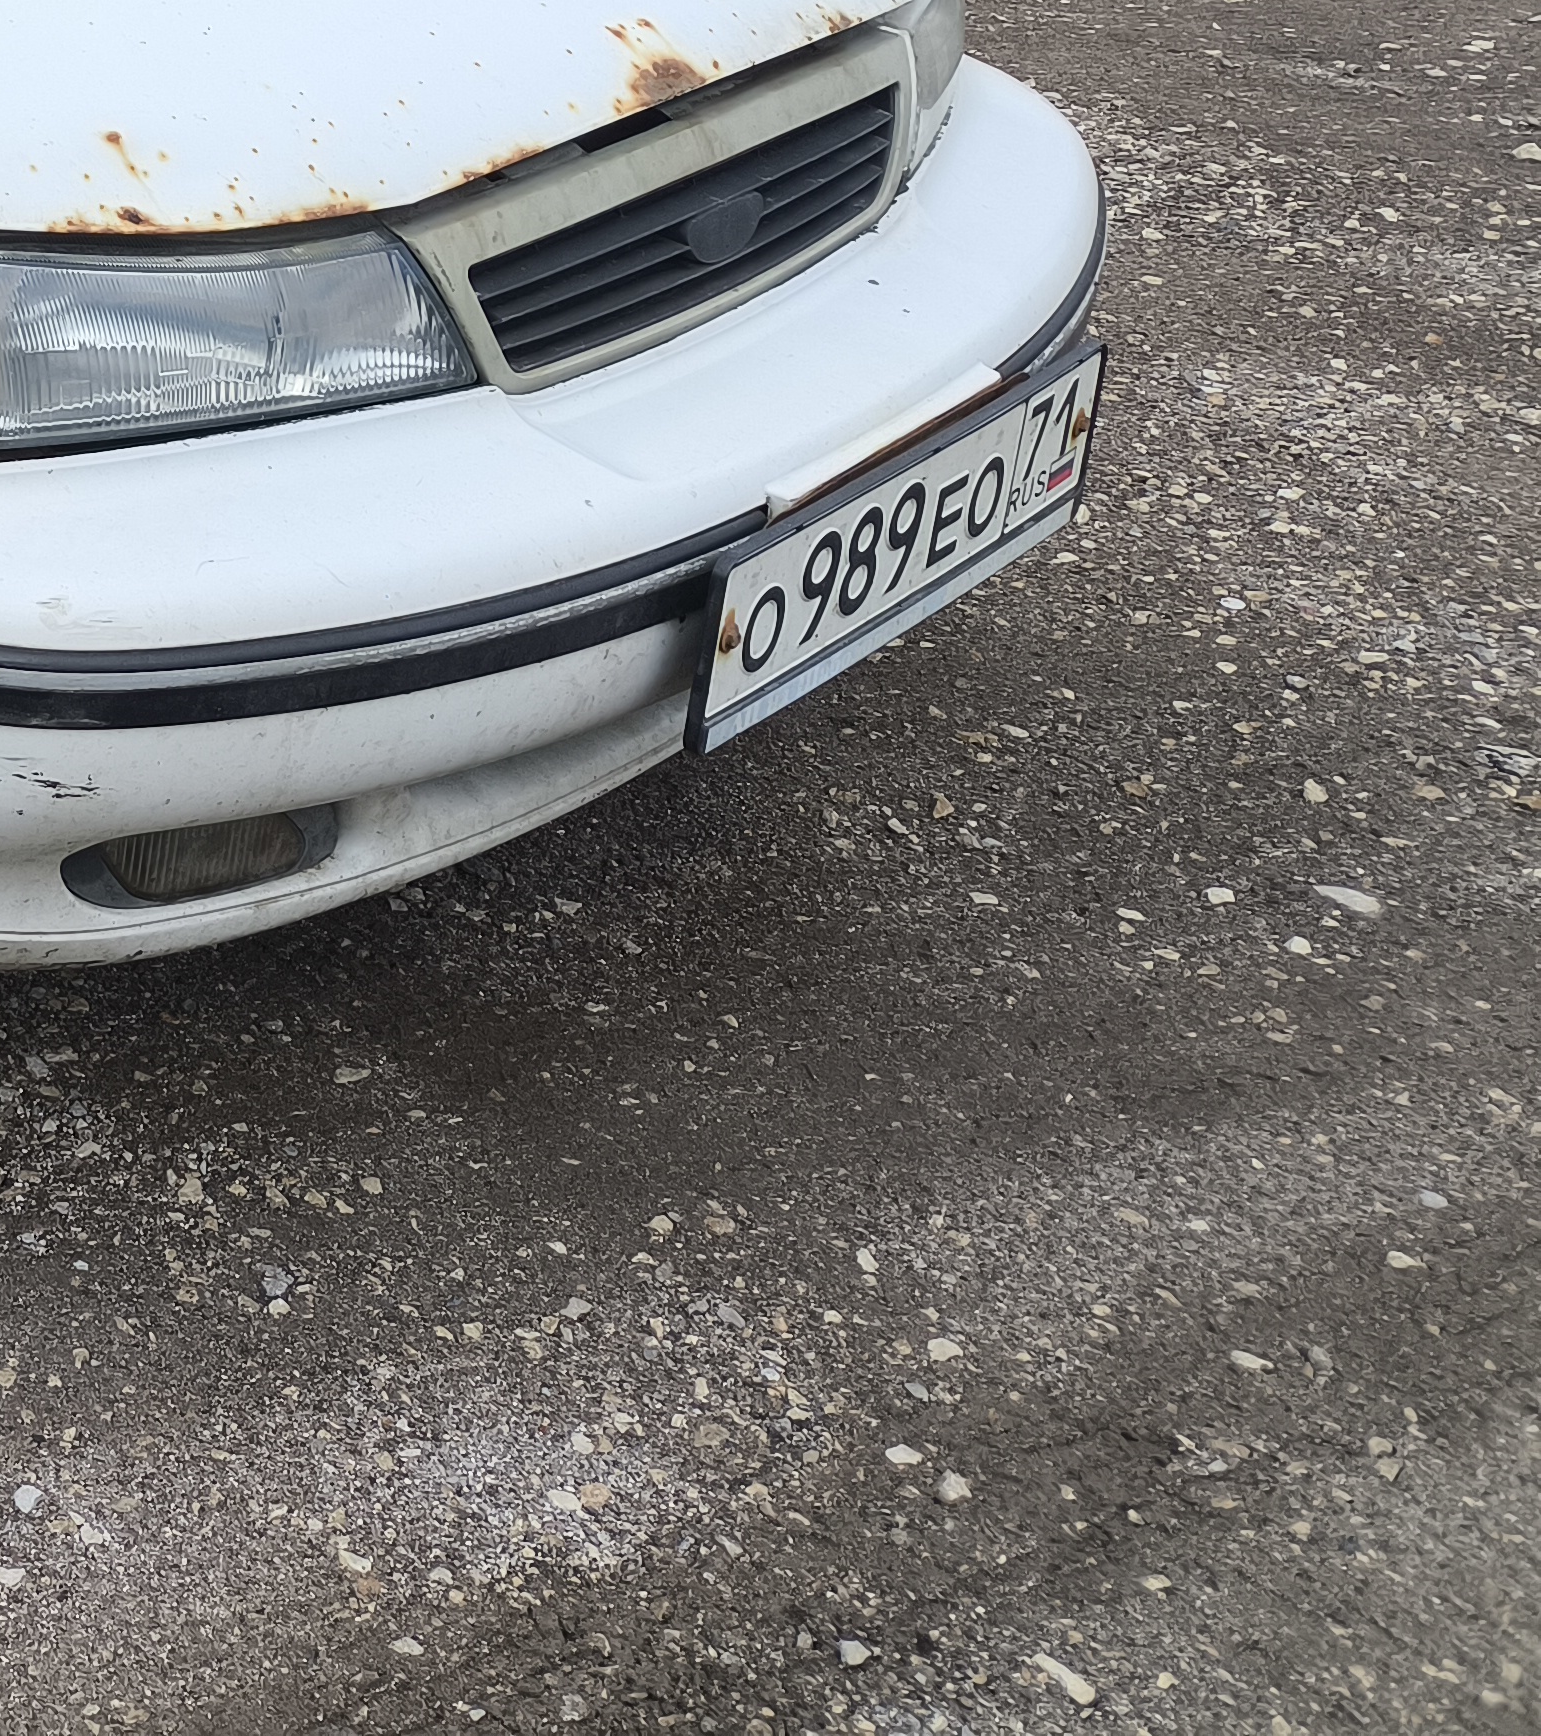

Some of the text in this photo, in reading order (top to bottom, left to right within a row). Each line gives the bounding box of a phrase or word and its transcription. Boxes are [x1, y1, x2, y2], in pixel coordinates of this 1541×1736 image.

[742, 455, 1006, 673] О989ЕО
[1022, 376, 1080, 482] 71
[1009, 469, 1048, 513] RUS
